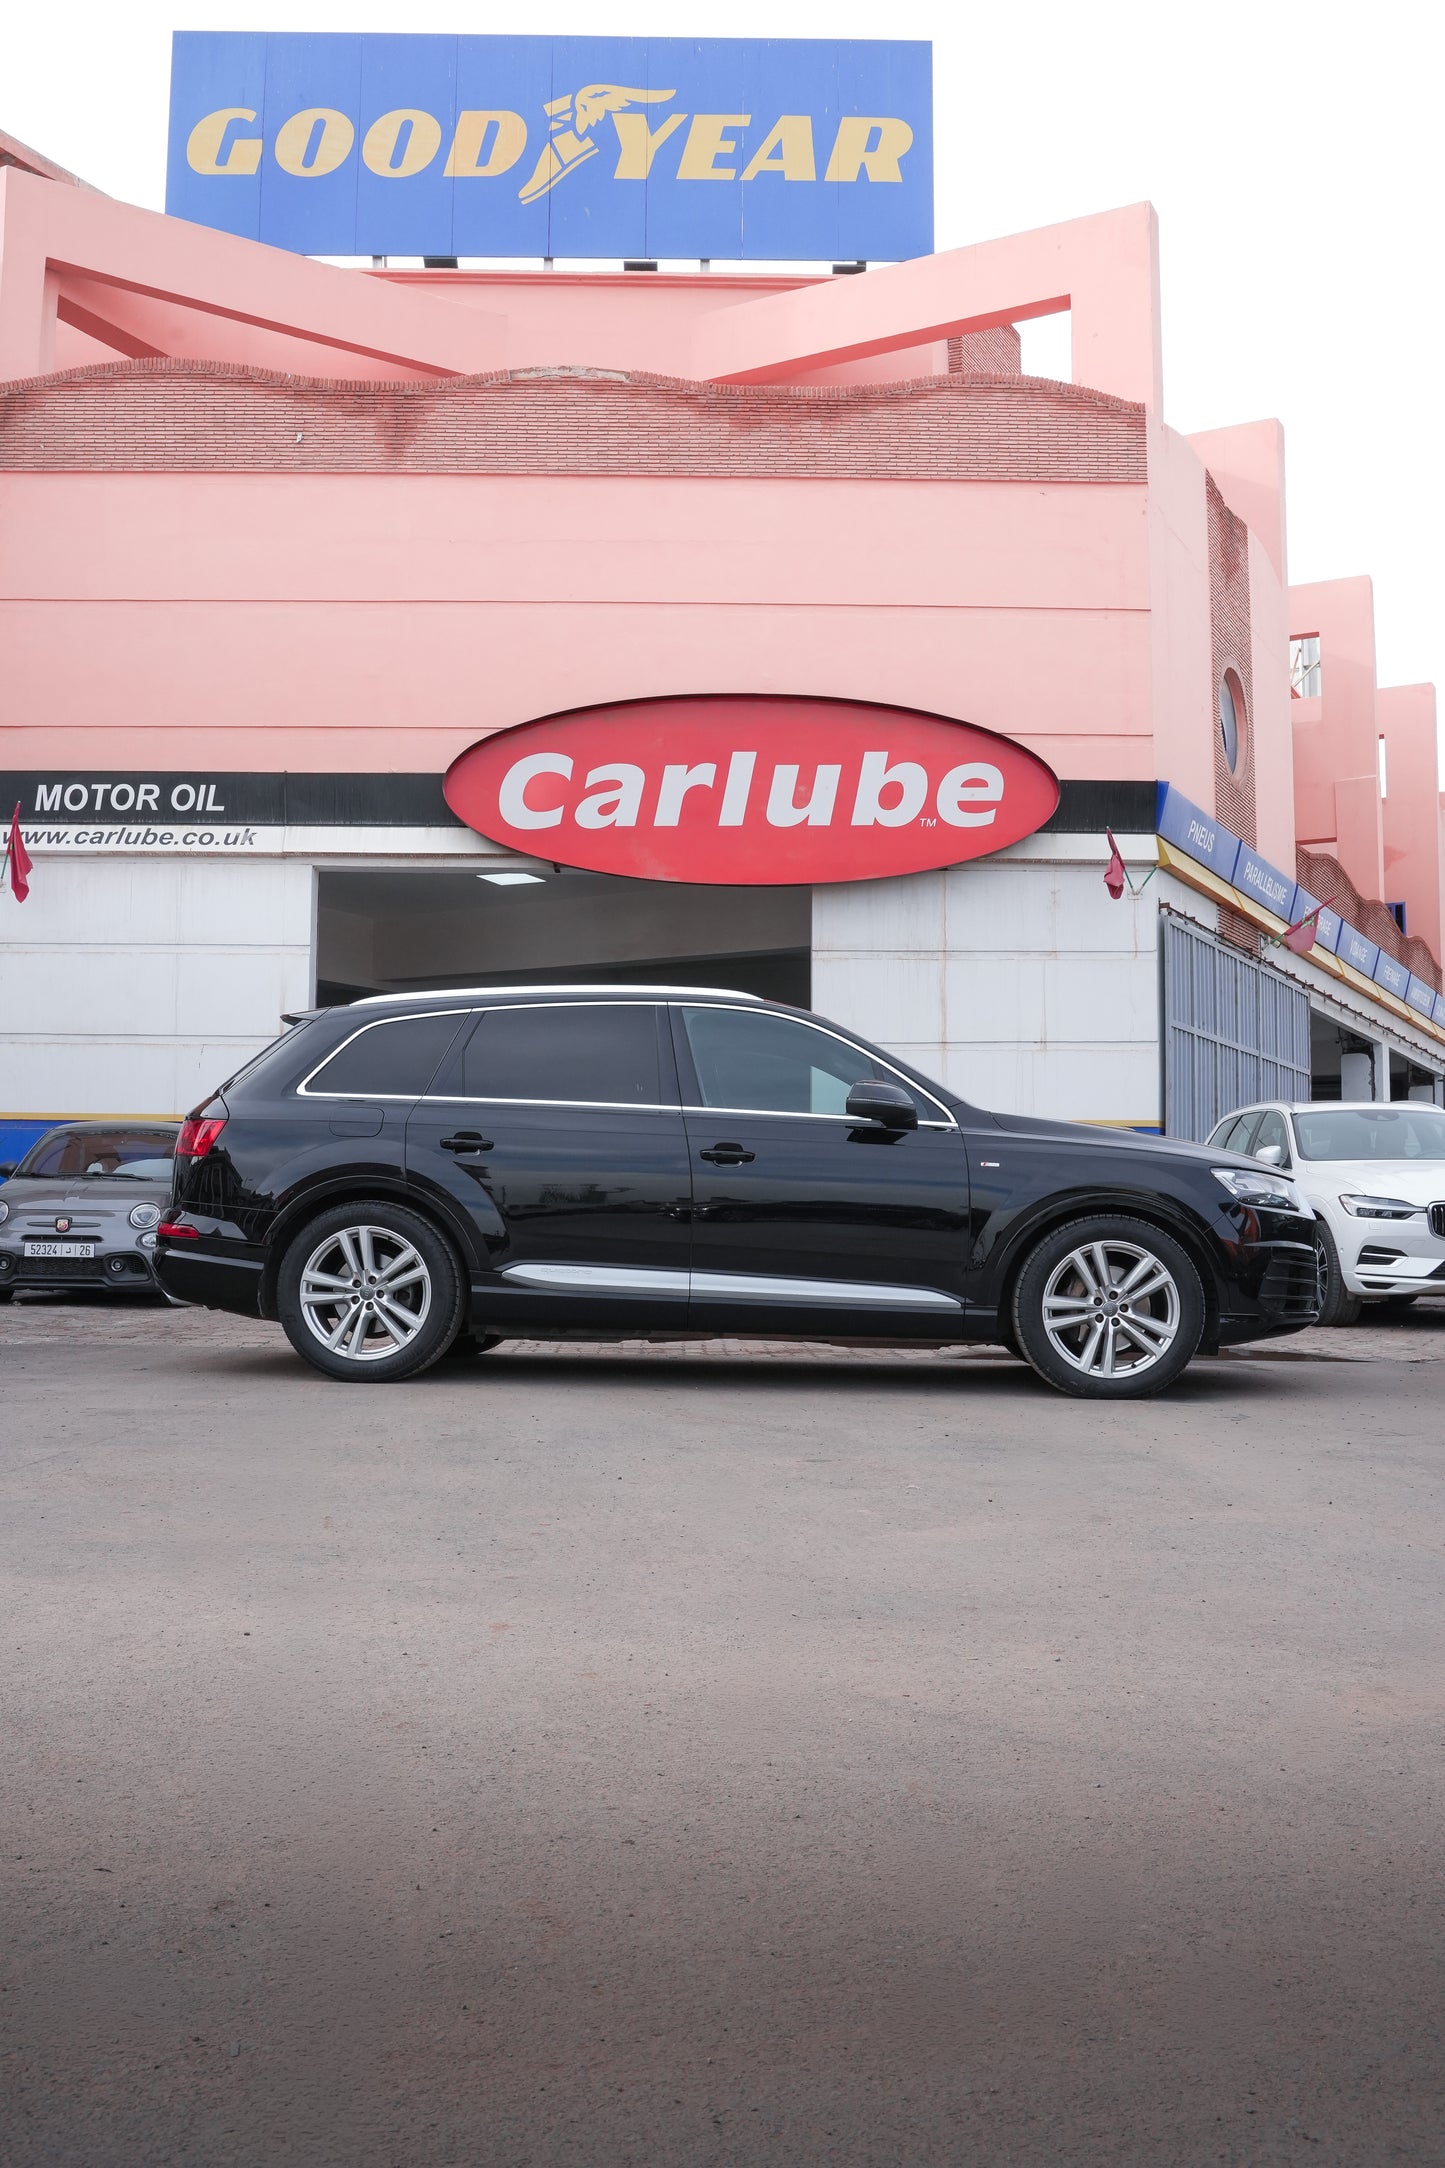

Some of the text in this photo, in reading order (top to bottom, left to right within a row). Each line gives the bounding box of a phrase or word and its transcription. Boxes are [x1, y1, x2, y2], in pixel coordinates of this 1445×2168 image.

[34, 783, 226, 812] MOTOR OIL
[498, 751, 1005, 830] Carlube
[1187, 819, 1215, 853] PNEUS
[1243, 861, 1288, 905] PARALLELISME
[30, 1244, 57, 1256] 52324
[79, 1244, 91, 1256] 26
